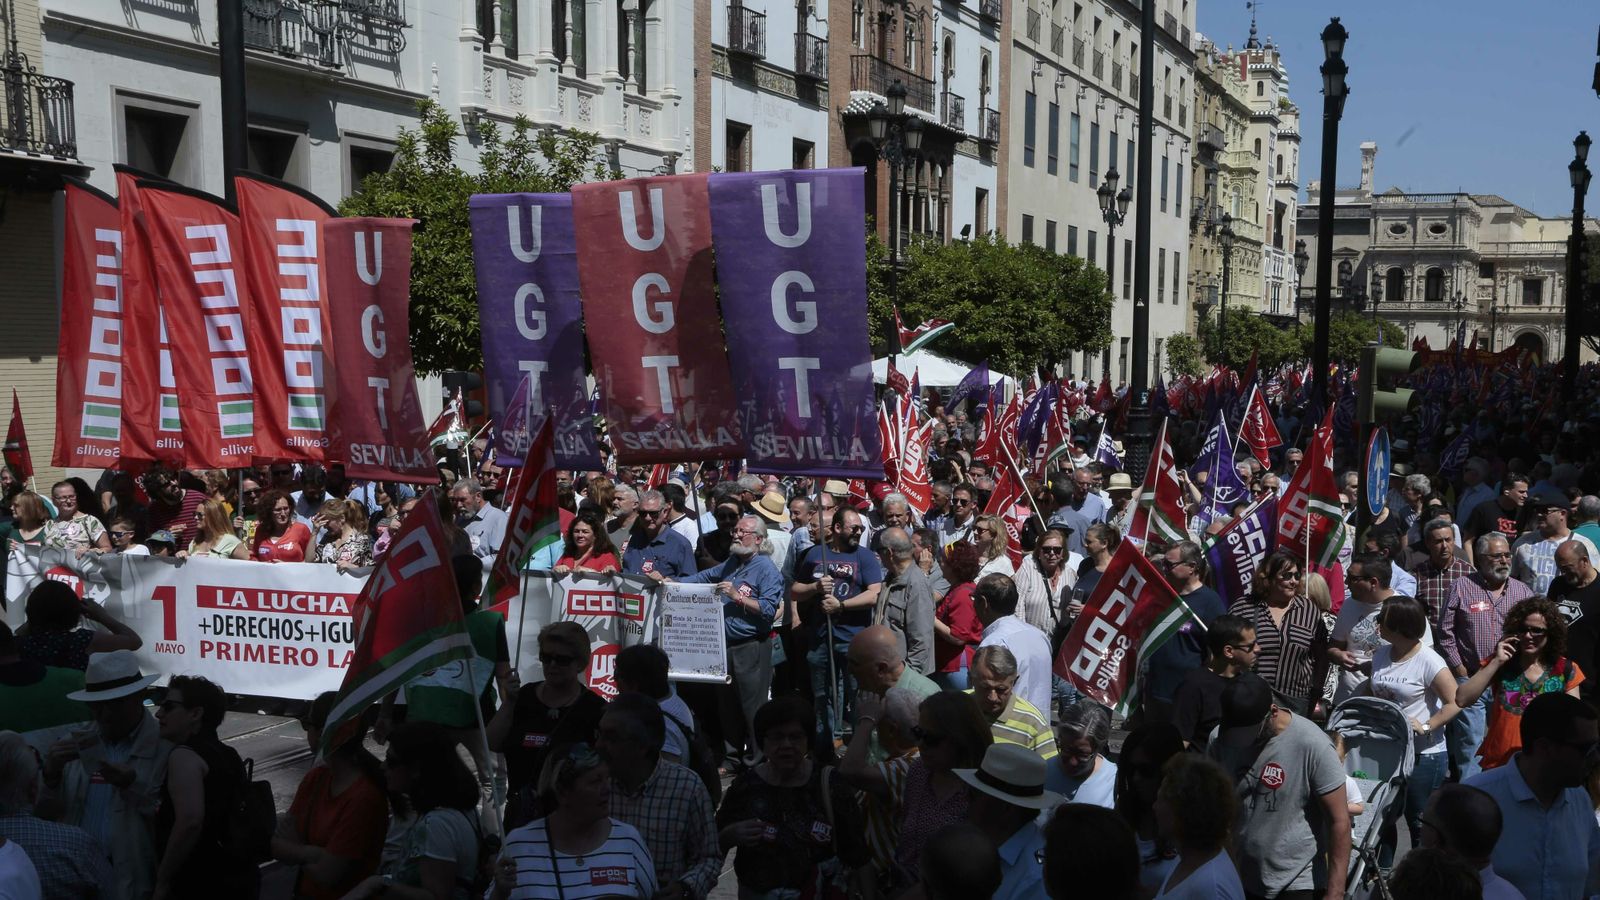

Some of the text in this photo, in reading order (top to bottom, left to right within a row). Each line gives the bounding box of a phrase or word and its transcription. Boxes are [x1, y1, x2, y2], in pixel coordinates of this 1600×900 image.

[506, 205, 549, 416] UGT
[618, 187, 679, 415] UGT
[761, 183, 820, 418] UGT
[354, 231, 390, 430] UGT
[621, 426, 738, 451] SEVILLA
[752, 434, 869, 463] SEVILLA
[350, 443, 428, 469] SEVILLA
[150, 586, 177, 641] 1
[216, 589, 350, 613] LA LUCHA
[571, 594, 625, 613] CCOO
[155, 642, 186, 655] MAYO
[200, 640, 319, 667] PRIMERO
[1264, 765, 1283, 779] UGT
